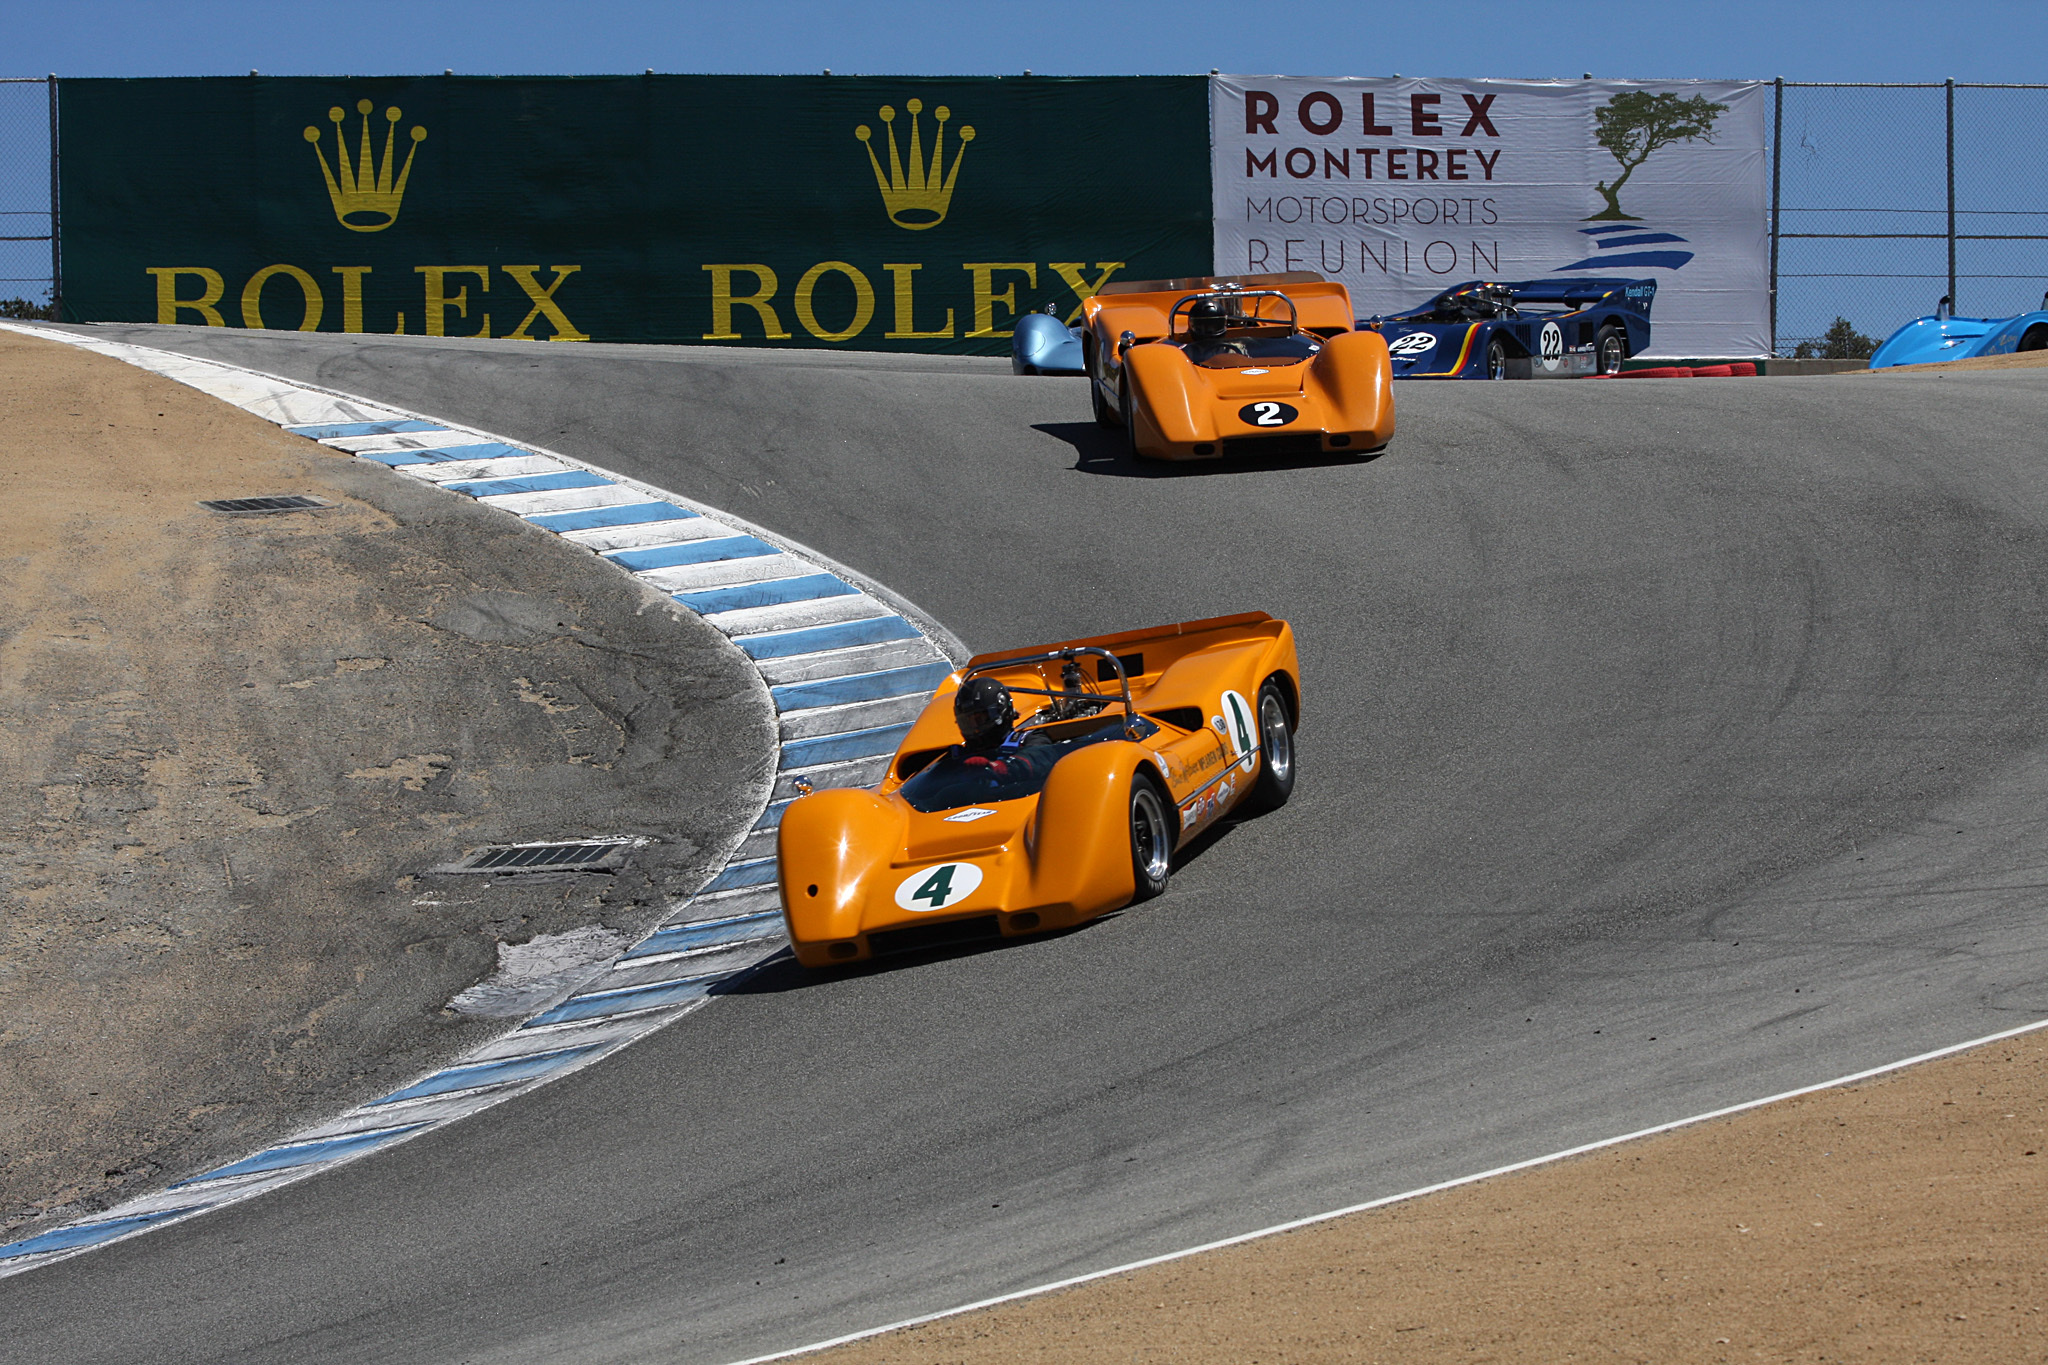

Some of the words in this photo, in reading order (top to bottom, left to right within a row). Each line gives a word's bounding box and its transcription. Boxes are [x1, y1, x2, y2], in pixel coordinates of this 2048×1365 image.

[1244, 91, 1500, 137] ROLEX
[1245, 147, 1501, 181] MONTEREY
[1246, 196, 1499, 225] MOTORSPORTS
[1248, 238, 1500, 275] REUNION
[146, 263, 590, 342] ROLEX
[702, 261, 1126, 342] ROLEX
[1392, 336, 1434, 350] 22
[1543, 329, 1560, 361] 22
[1254, 402, 1284, 425] 2
[1227, 692, 1253, 767] 4
[911, 864, 957, 908] 4
